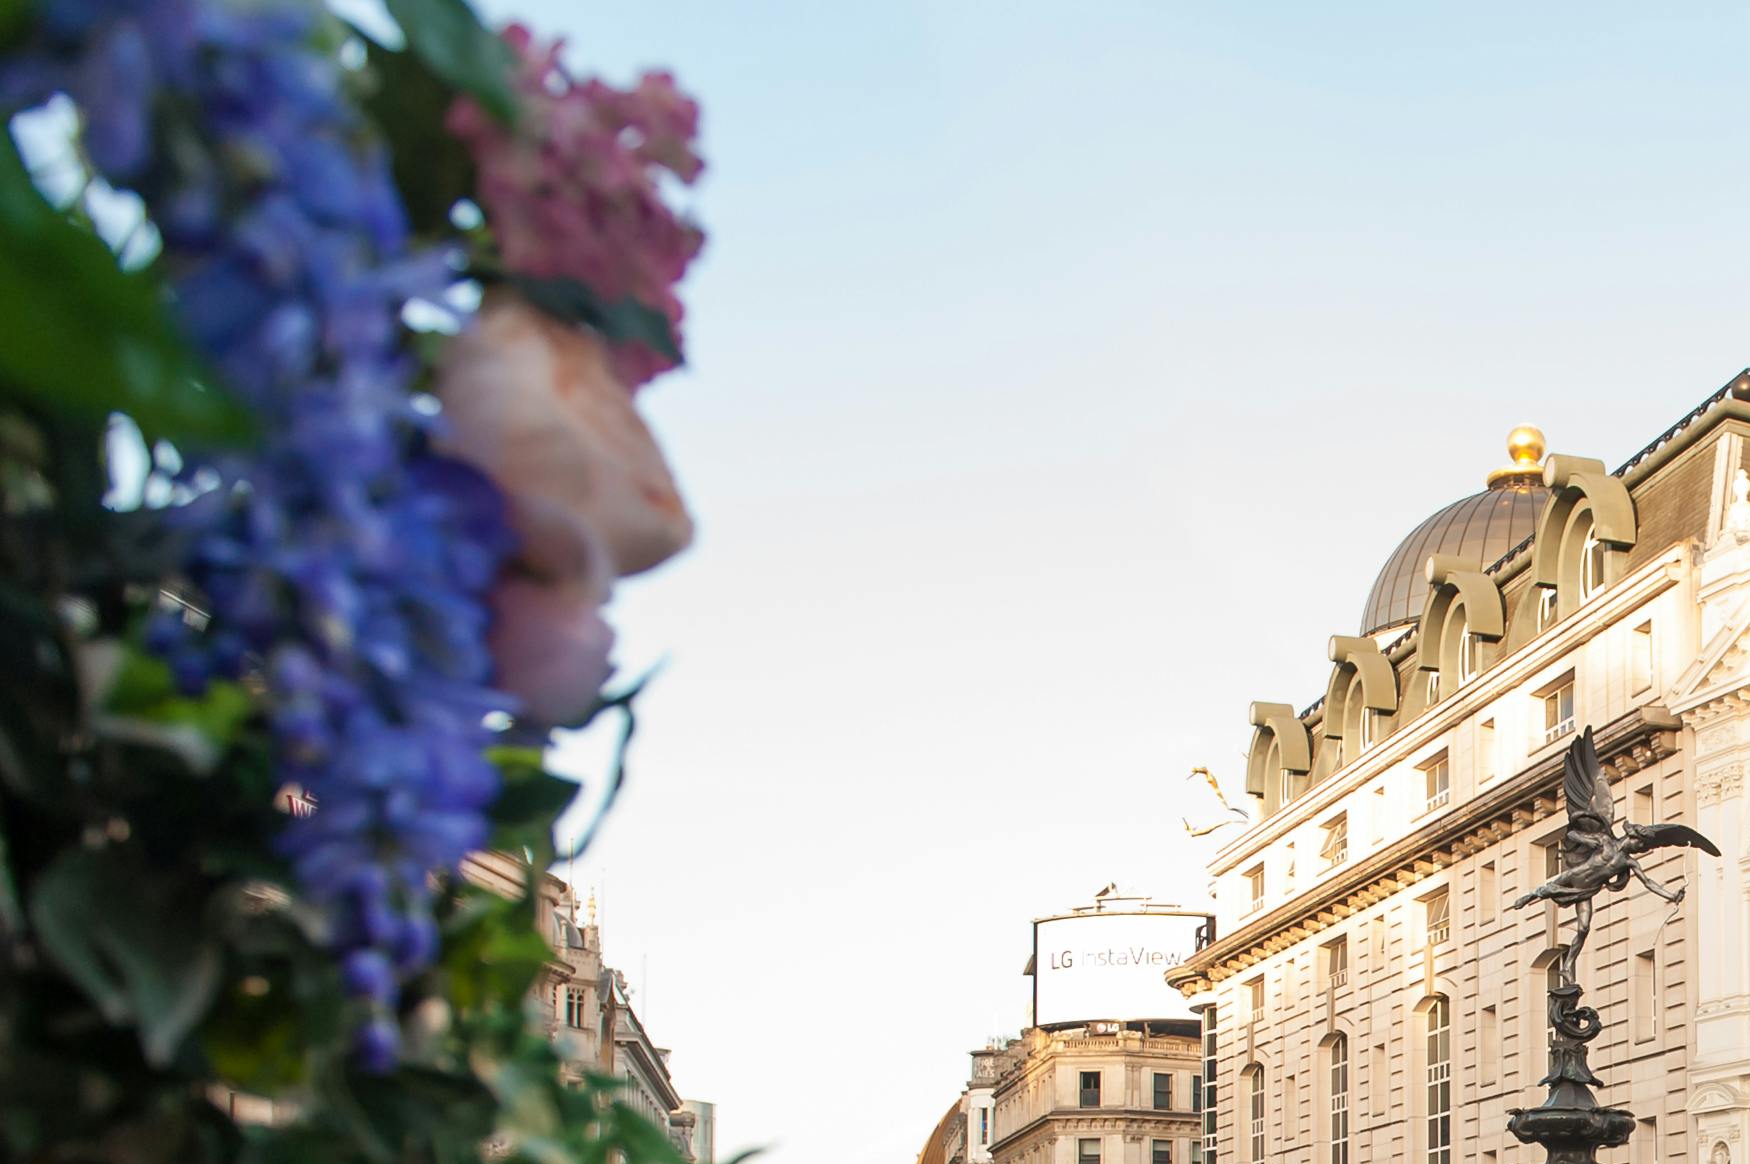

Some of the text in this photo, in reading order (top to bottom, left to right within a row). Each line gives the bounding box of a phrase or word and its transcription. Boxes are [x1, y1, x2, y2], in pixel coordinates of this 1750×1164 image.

[1051, 947, 1181, 970] LG InstaView
[1107, 1023, 1119, 1032] LG
